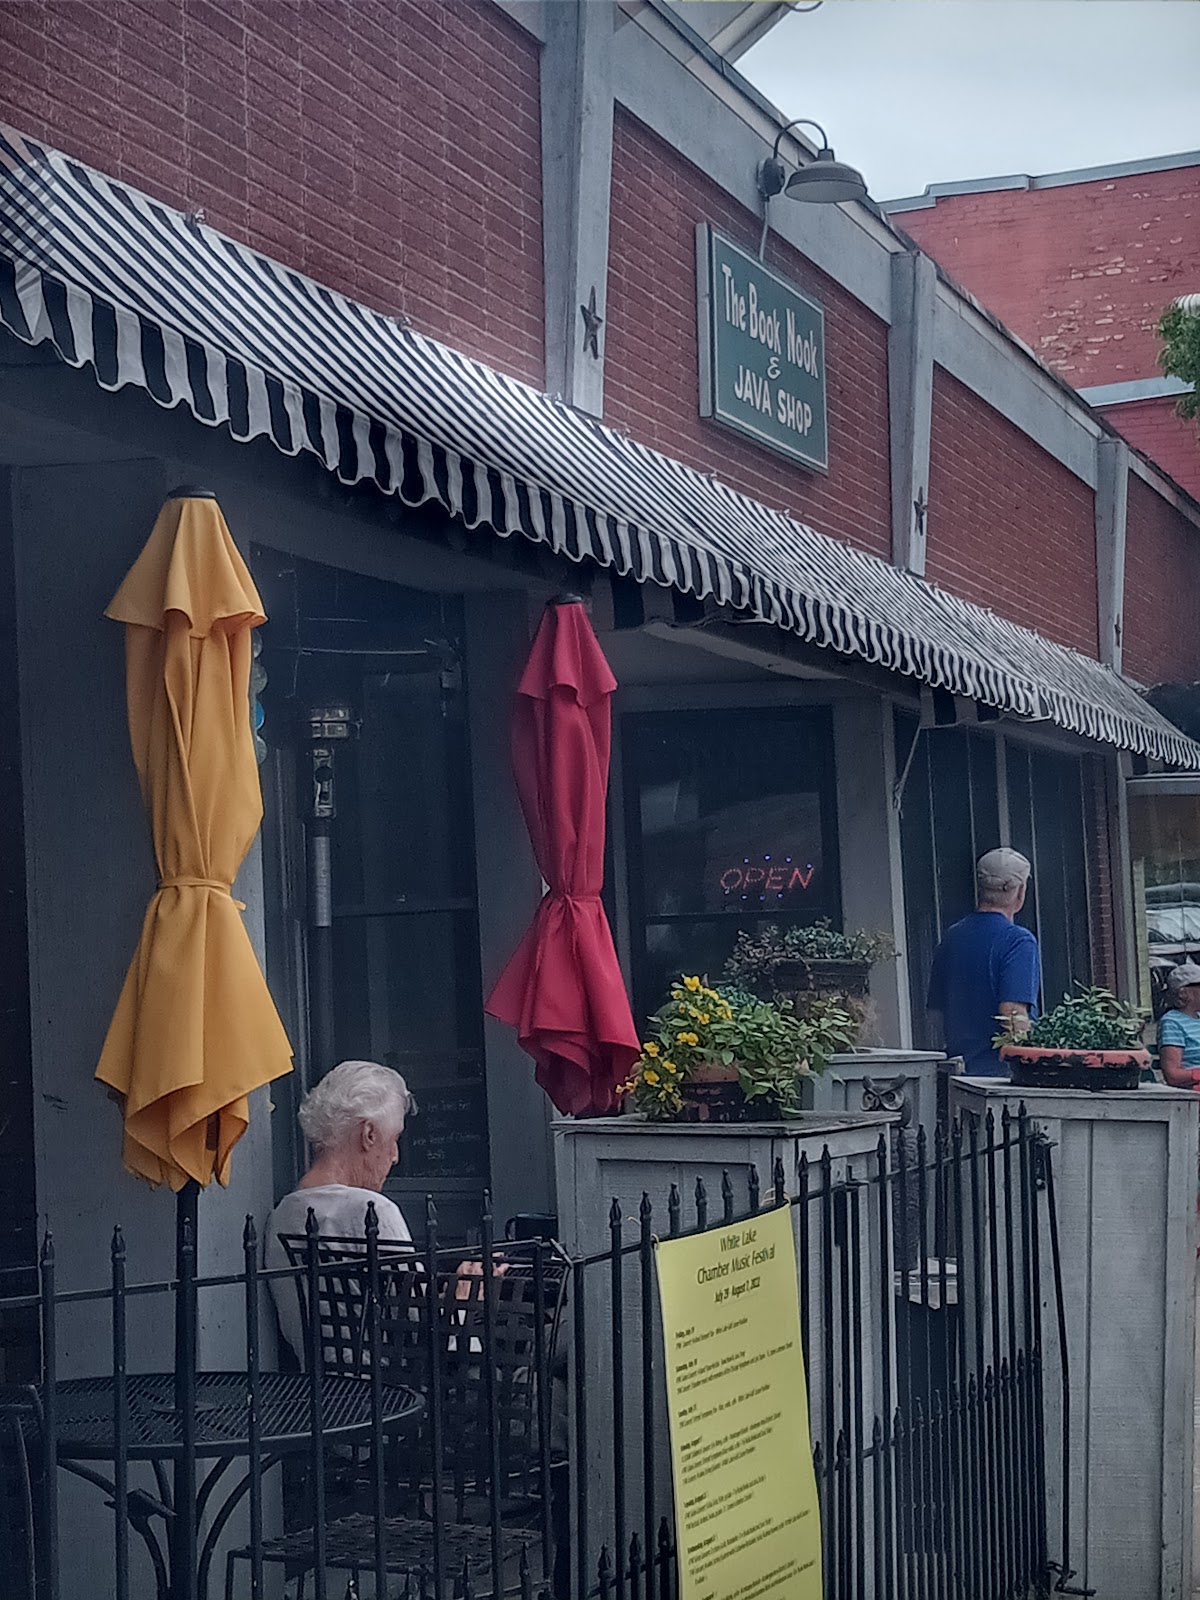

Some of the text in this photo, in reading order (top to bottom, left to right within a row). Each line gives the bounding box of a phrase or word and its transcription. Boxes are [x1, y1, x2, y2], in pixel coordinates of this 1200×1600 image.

[721, 262, 819, 379] The Book Nook
[767, 356, 781, 380] &
[733, 364, 813, 437] JAVA SHOP
[720, 867, 815, 890] OPEN
[720, 1228, 757, 1252] White Lake
[697, 1243, 775, 1285] Chamber Music Festival
